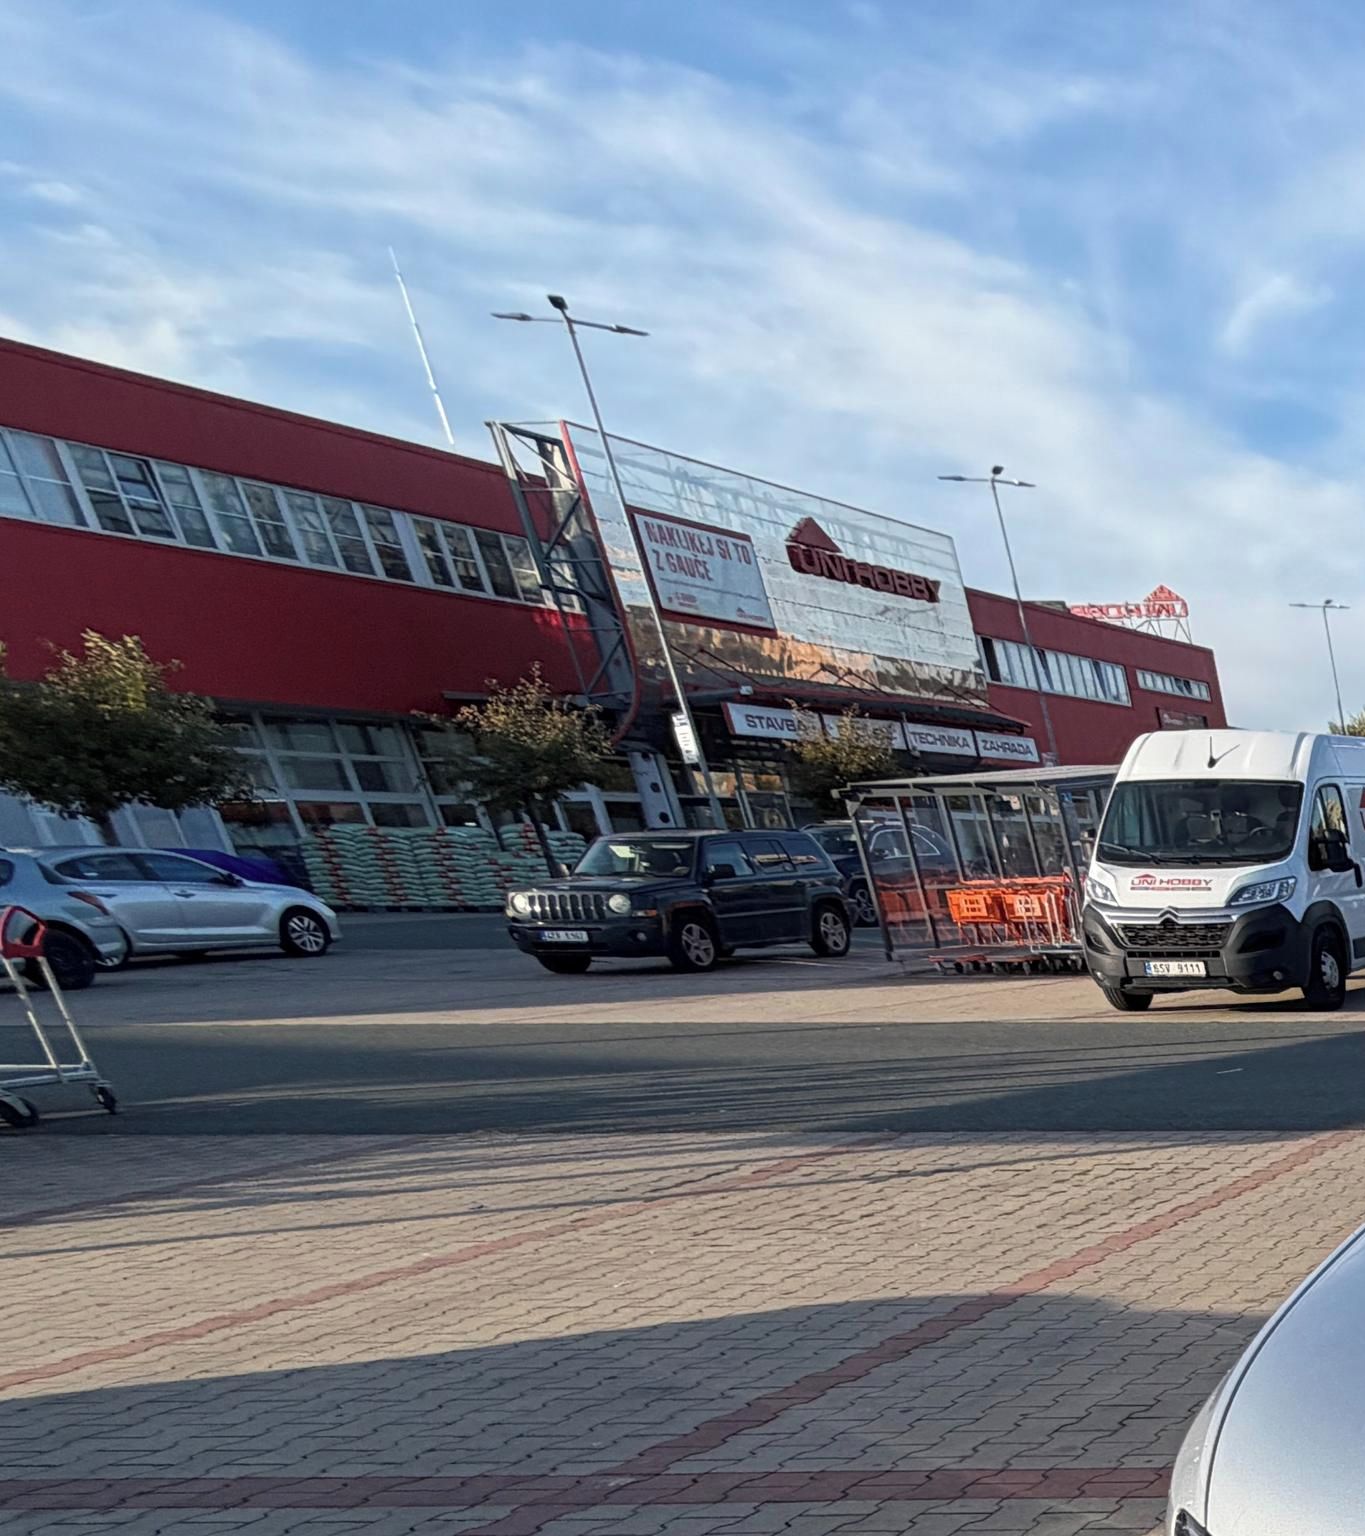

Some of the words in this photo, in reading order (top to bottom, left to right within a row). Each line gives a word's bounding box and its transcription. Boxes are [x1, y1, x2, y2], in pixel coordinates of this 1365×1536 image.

[644, 520, 714, 556] NAKLIKEJ
[716, 538, 732, 561] SI
[733, 542, 752, 565] TO
[652, 549, 664, 571] Z
[666, 552, 713, 581] GAUČE
[787, 545, 852, 583] UNI
[853, 562, 941, 603] HOBBY
[910, 730, 970, 749] TECHNIKA
[982, 738, 1033, 757] ZAHRADA
